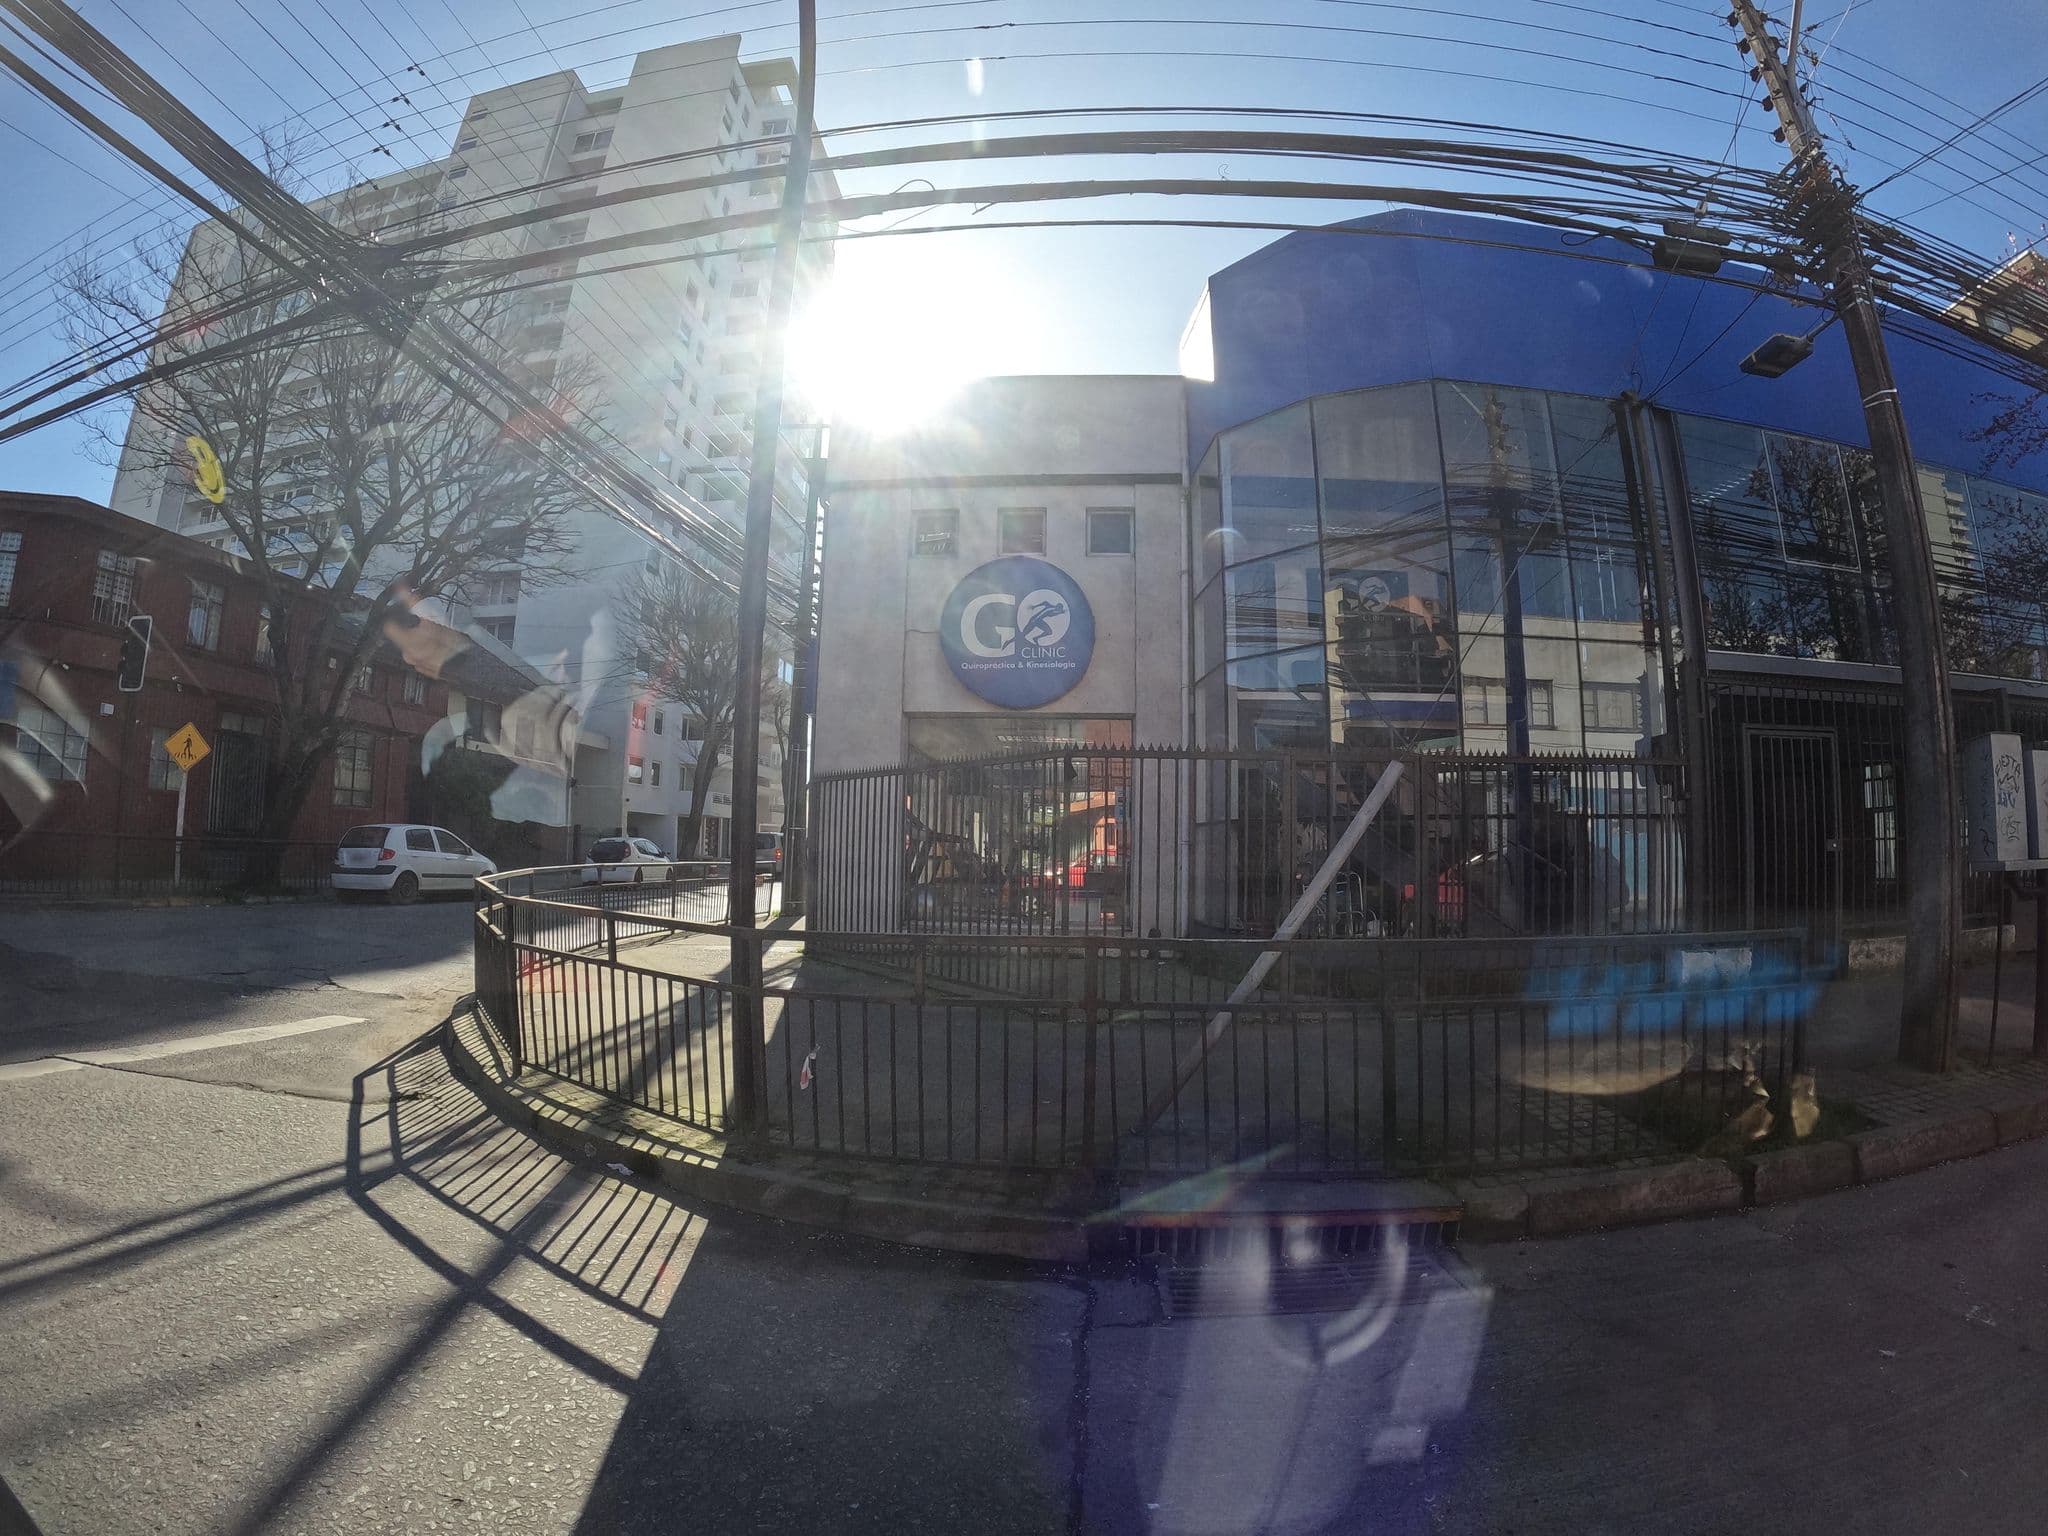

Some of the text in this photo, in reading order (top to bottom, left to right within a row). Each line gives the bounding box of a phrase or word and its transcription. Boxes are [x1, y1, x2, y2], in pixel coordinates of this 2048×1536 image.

[960, 589, 1071, 658] GO
[1021, 647, 1066, 659] CLINIC
[1017, 661, 1024, 669] &
